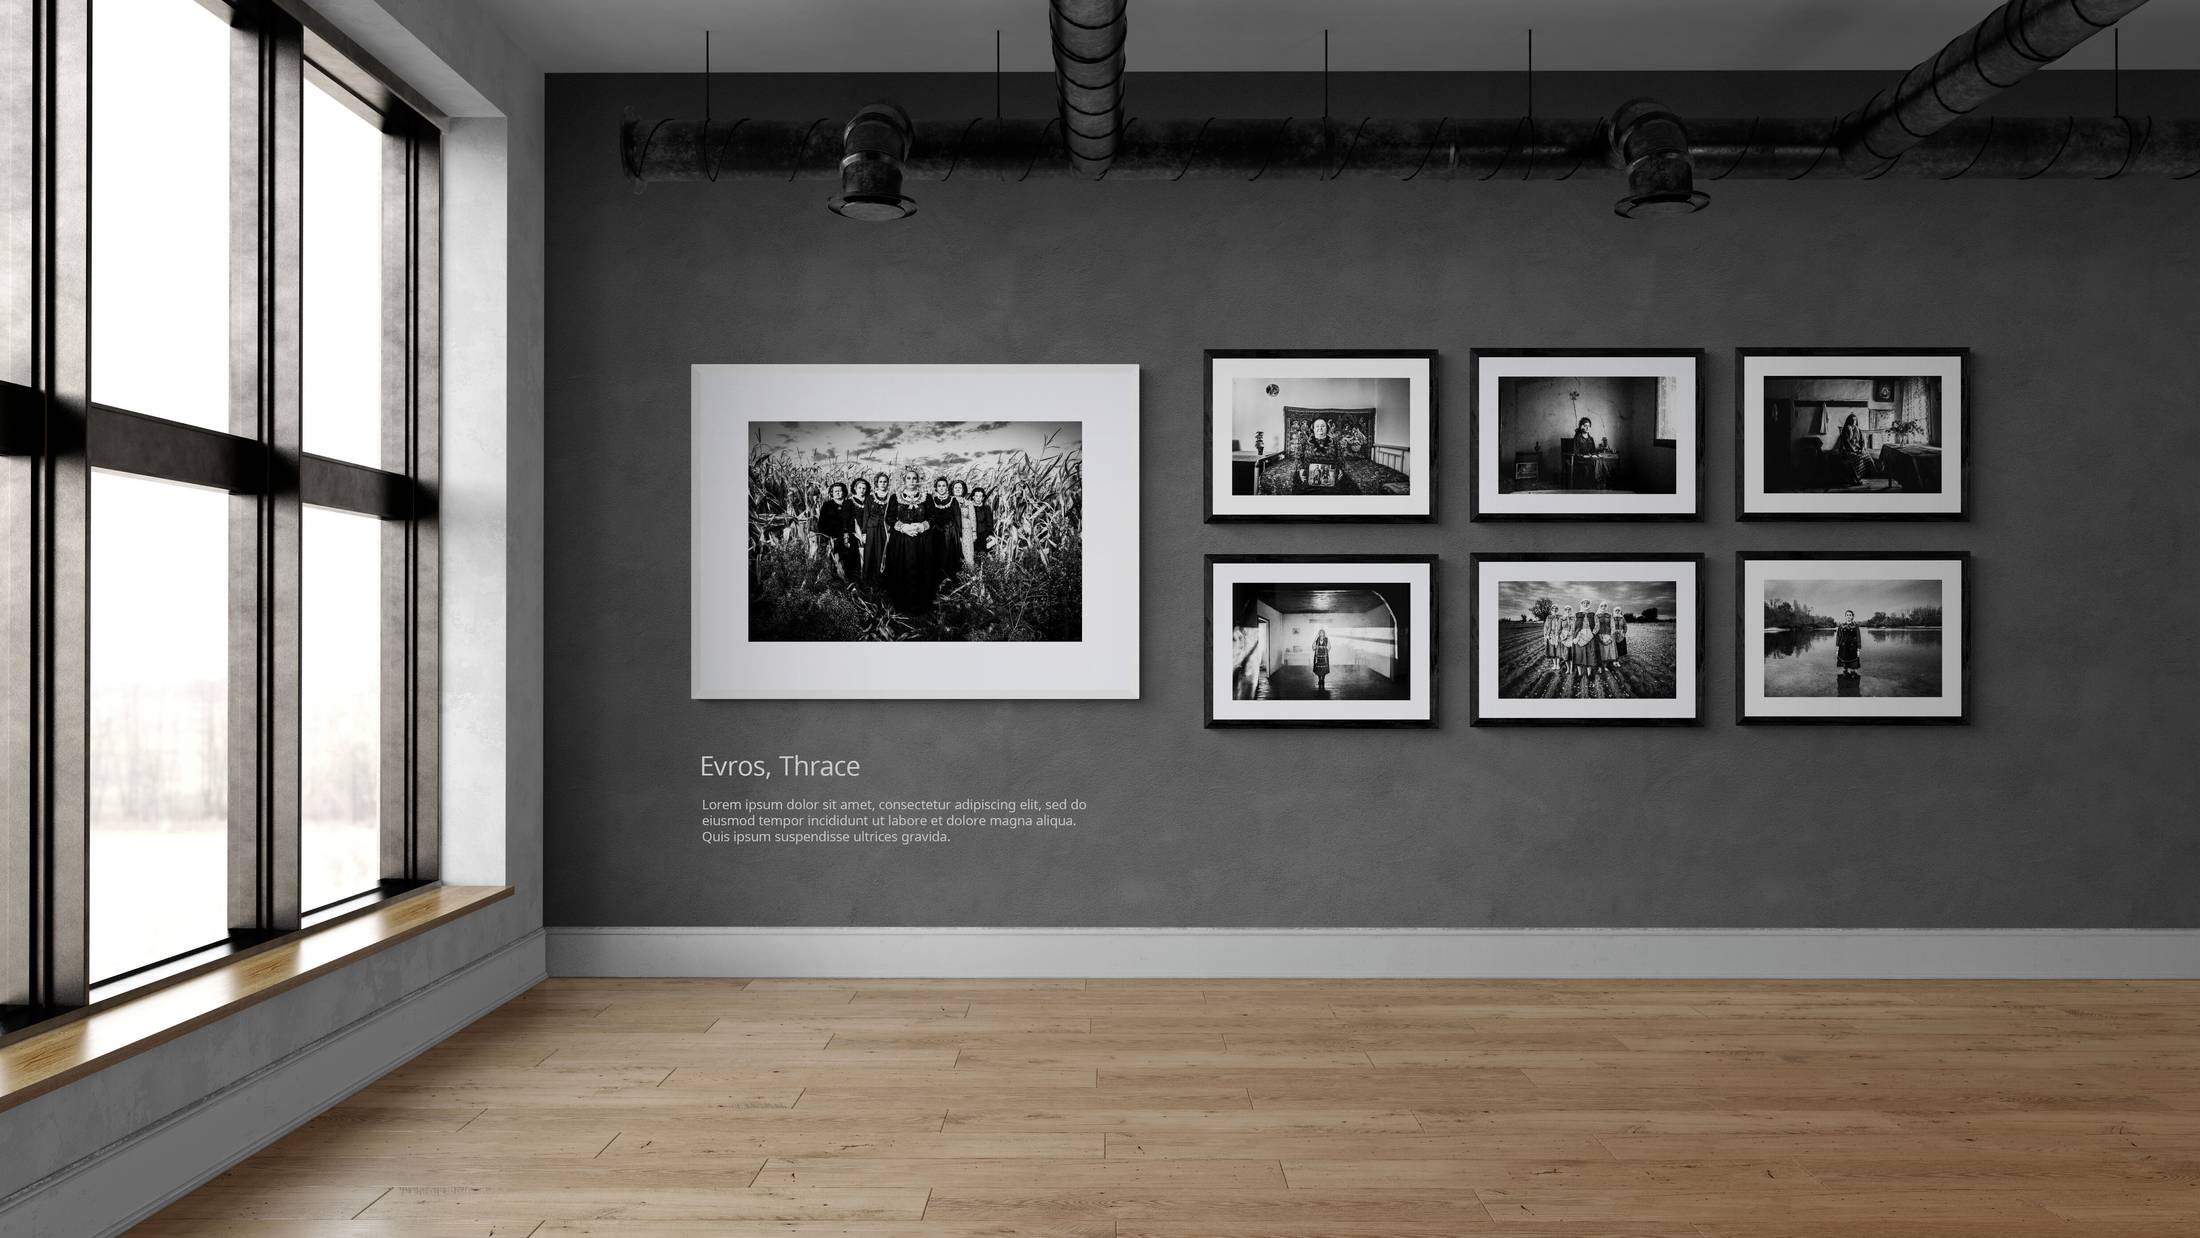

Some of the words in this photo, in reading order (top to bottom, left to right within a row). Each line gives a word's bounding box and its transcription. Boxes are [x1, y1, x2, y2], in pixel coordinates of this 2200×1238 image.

[701, 756, 770, 779] Evros,
[779, 755, 860, 776] Thrace
[703, 800, 741, 810] Lorem
[746, 799, 782, 813] ipsum
[787, 799, 819, 810] dolor
[823, 800, 837, 810] sit
[840, 800, 875, 811] amet,
[879, 800, 951, 810] consectetur
[955, 798, 1015, 813] adipiscing
[1020, 799, 1041, 811] elit,
[1046, 799, 1067, 810] sed
[1071, 799, 1086, 810] do
[702, 815, 755, 826] eiusmod
[759, 816, 804, 829] tempor
[808, 815, 868, 826] incididunt
[873, 816, 885, 826] ut
[889, 815, 927, 826] labore
[931, 816, 943, 826] et
[947, 815, 986, 826] dolore
[990, 818, 1032, 829] magna
[1036, 815, 1076, 829] aliqua.
[702, 831, 730, 844] Quis
[734, 831, 771, 845] ipsum
[775, 831, 849, 845] suspendisse
[854, 831, 897, 842] ultrices
[902, 831, 950, 845] gravida.
